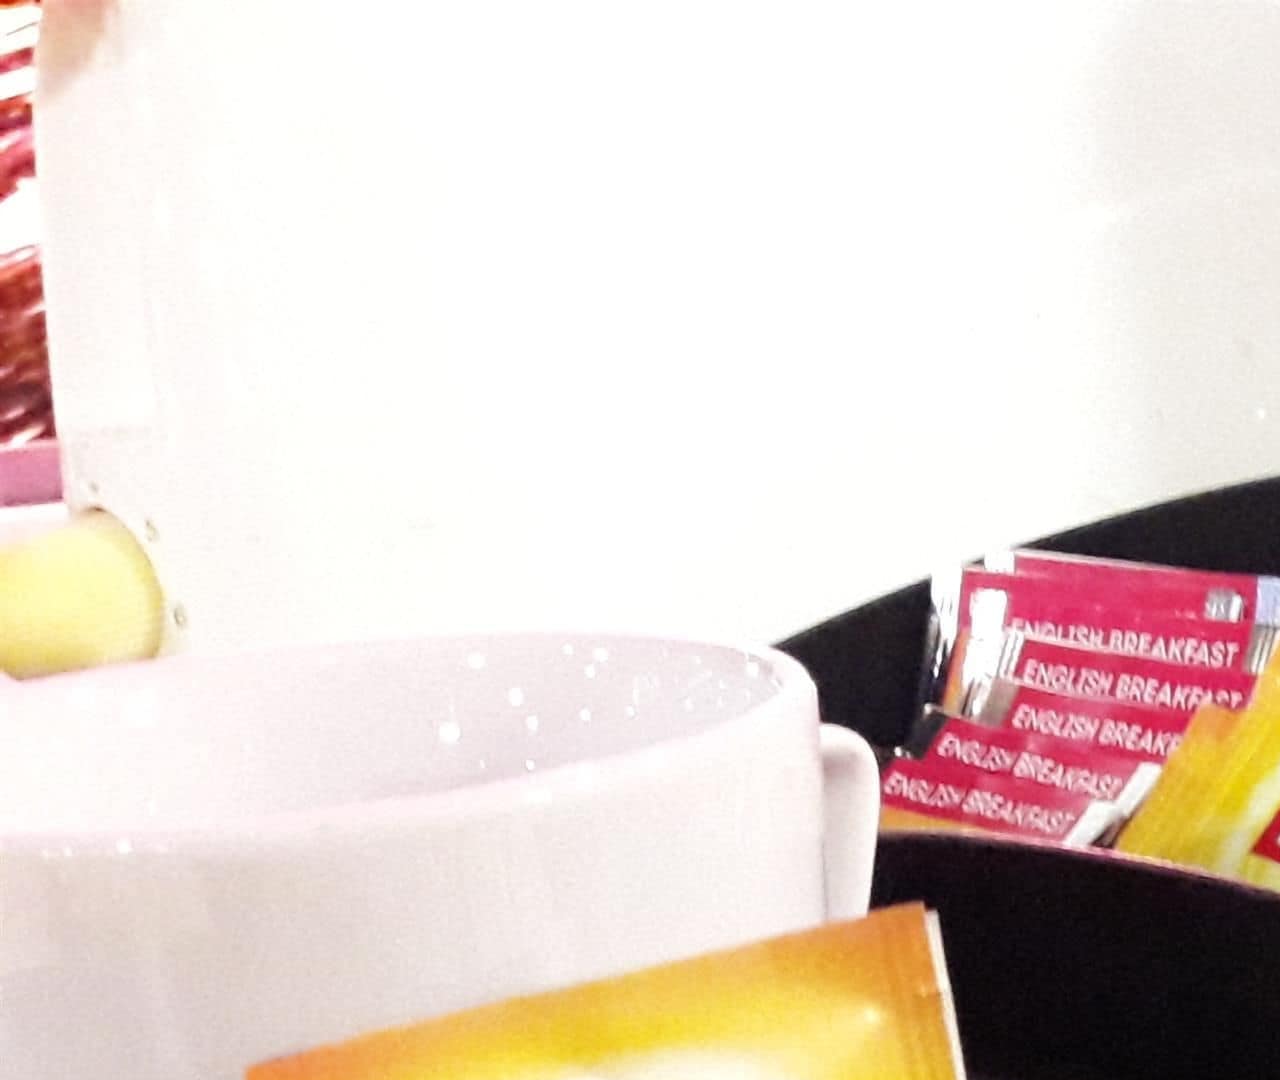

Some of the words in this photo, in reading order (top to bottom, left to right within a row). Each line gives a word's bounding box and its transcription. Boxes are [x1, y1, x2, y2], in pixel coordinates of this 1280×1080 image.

[1108, 627, 1241, 669] BREAKFAST
[1022, 658, 1114, 698] ENGLISH
[1011, 702, 1100, 744] ENGLISH
[936, 731, 1016, 774] ENGLISH
[1013, 751, 1126, 801] BREAKFAST
